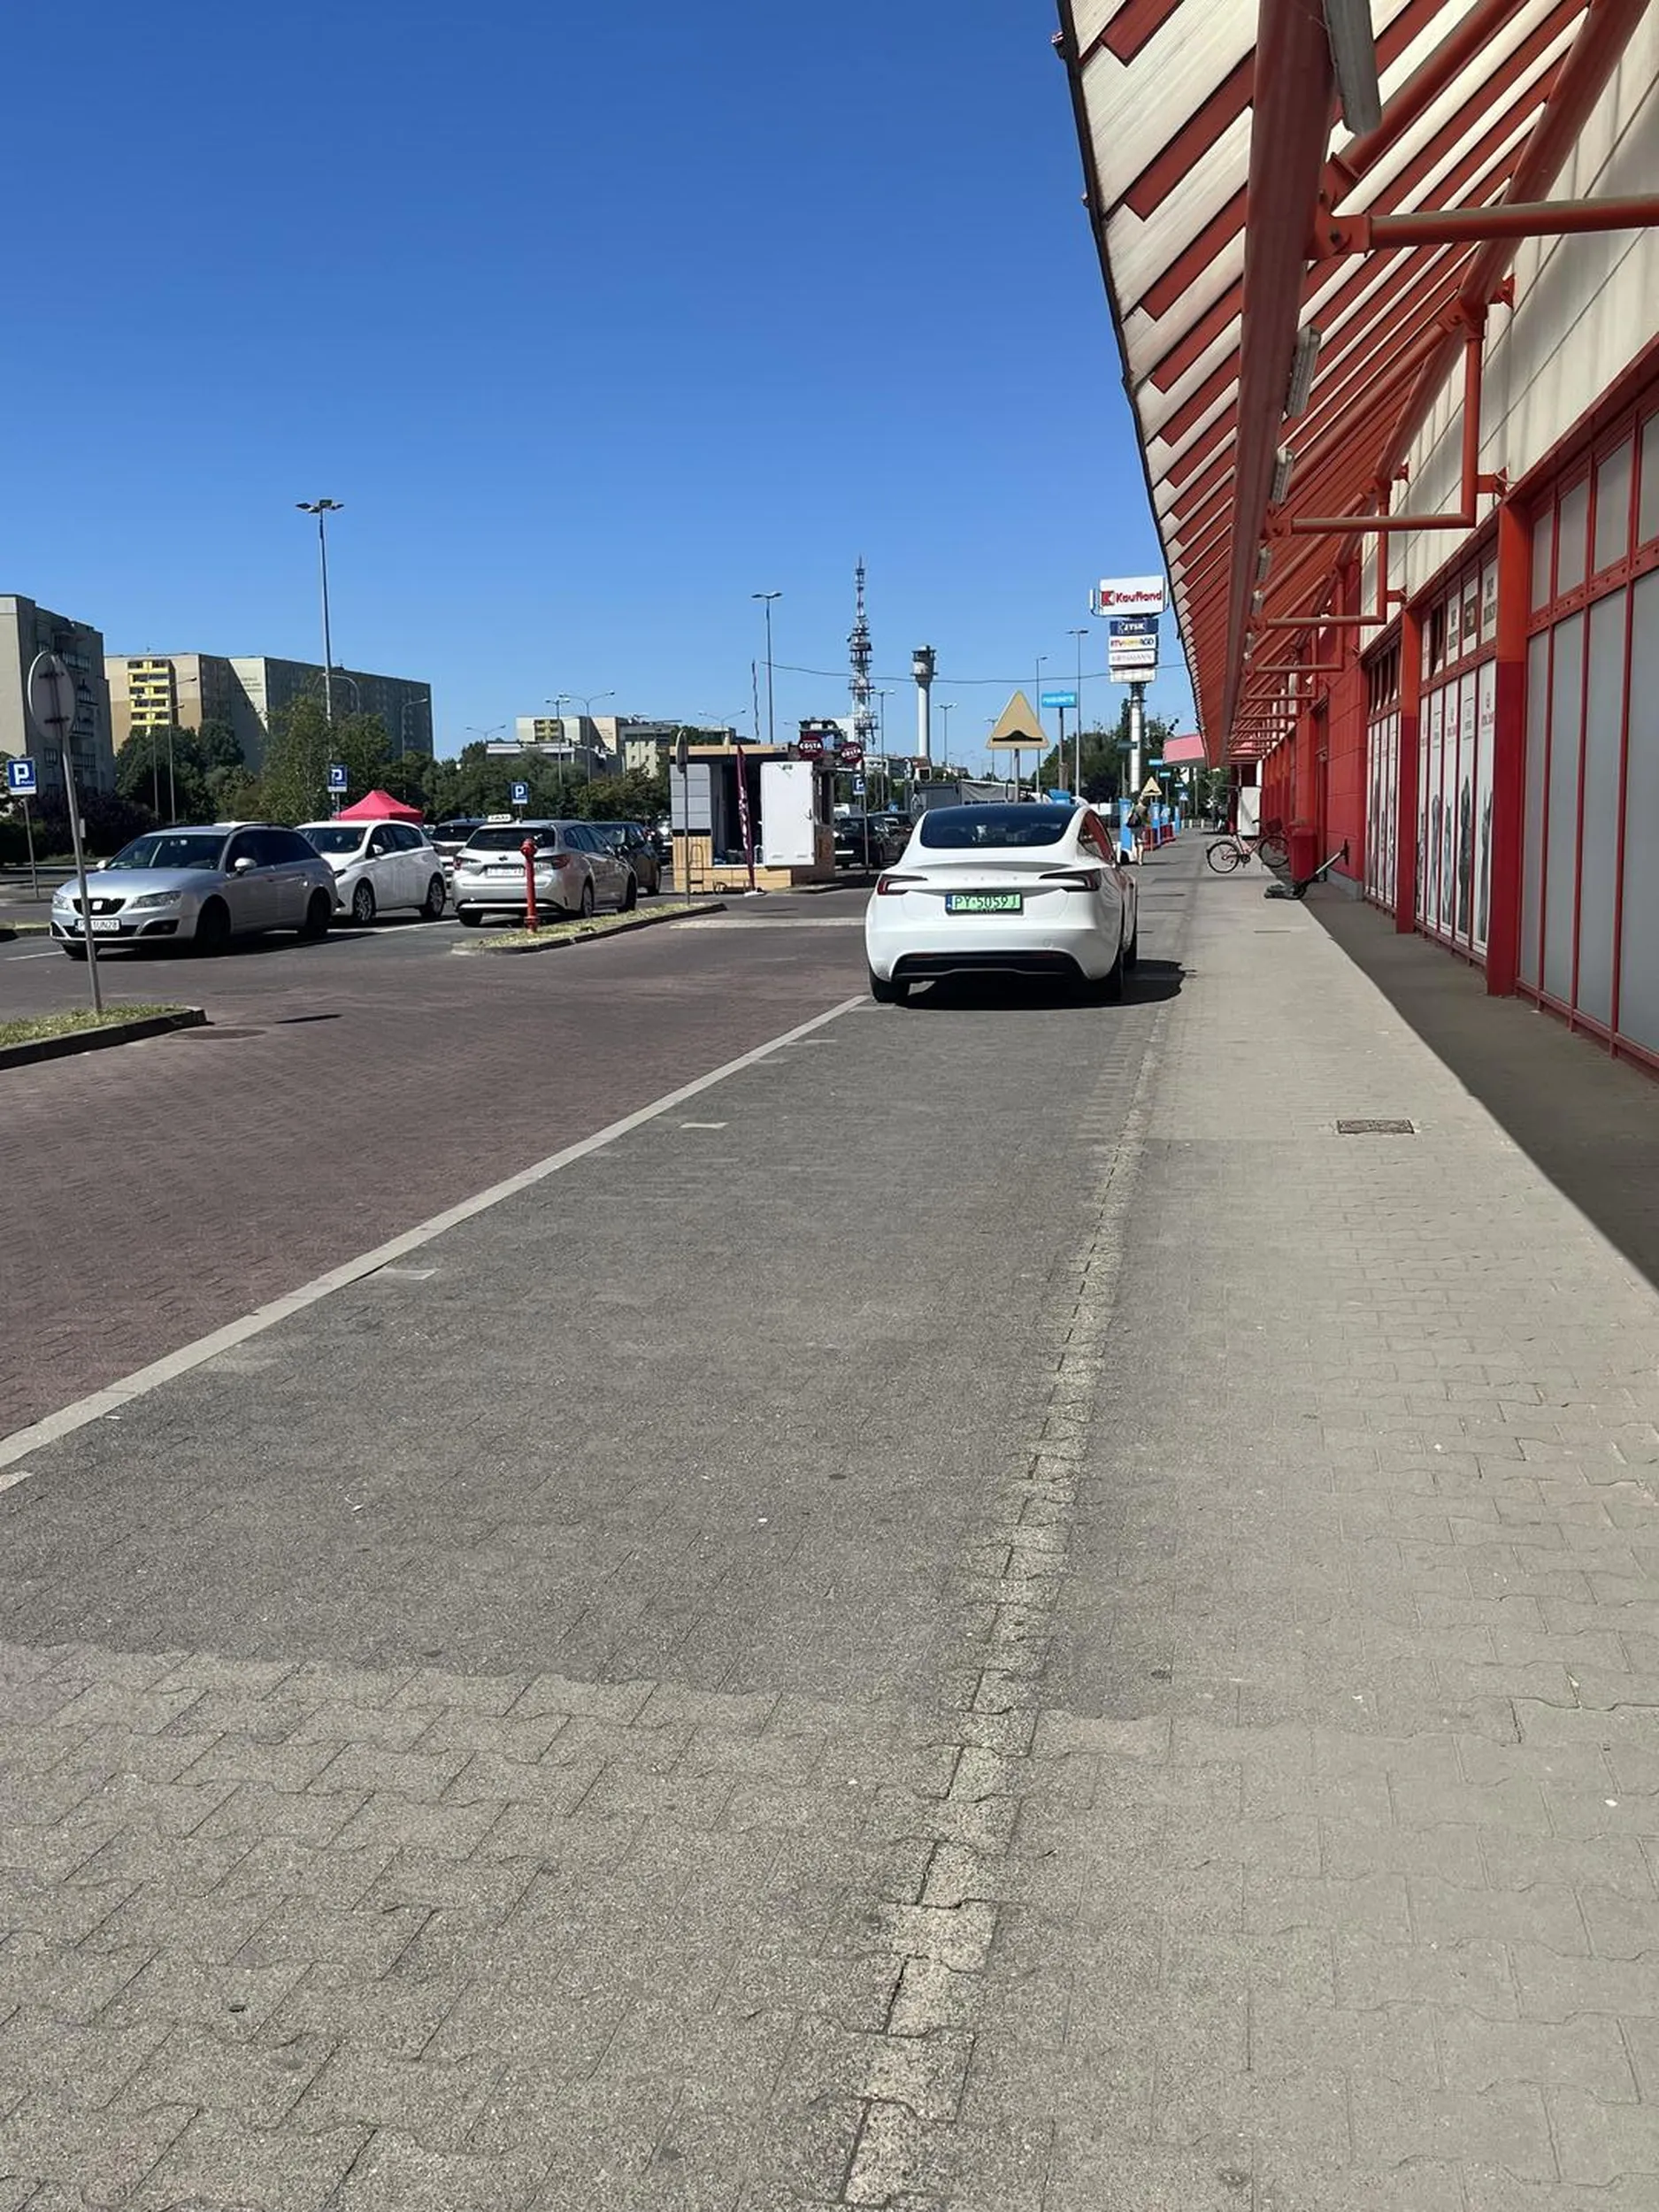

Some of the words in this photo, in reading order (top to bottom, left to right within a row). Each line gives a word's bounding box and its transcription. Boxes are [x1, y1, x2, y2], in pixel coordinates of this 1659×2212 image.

[1116, 590, 1162, 603] Kaufland
[841, 749, 861, 758] COSTA
[13, 764, 29, 785] P
[331, 769, 342, 785] P
[515, 785, 525, 798] P
